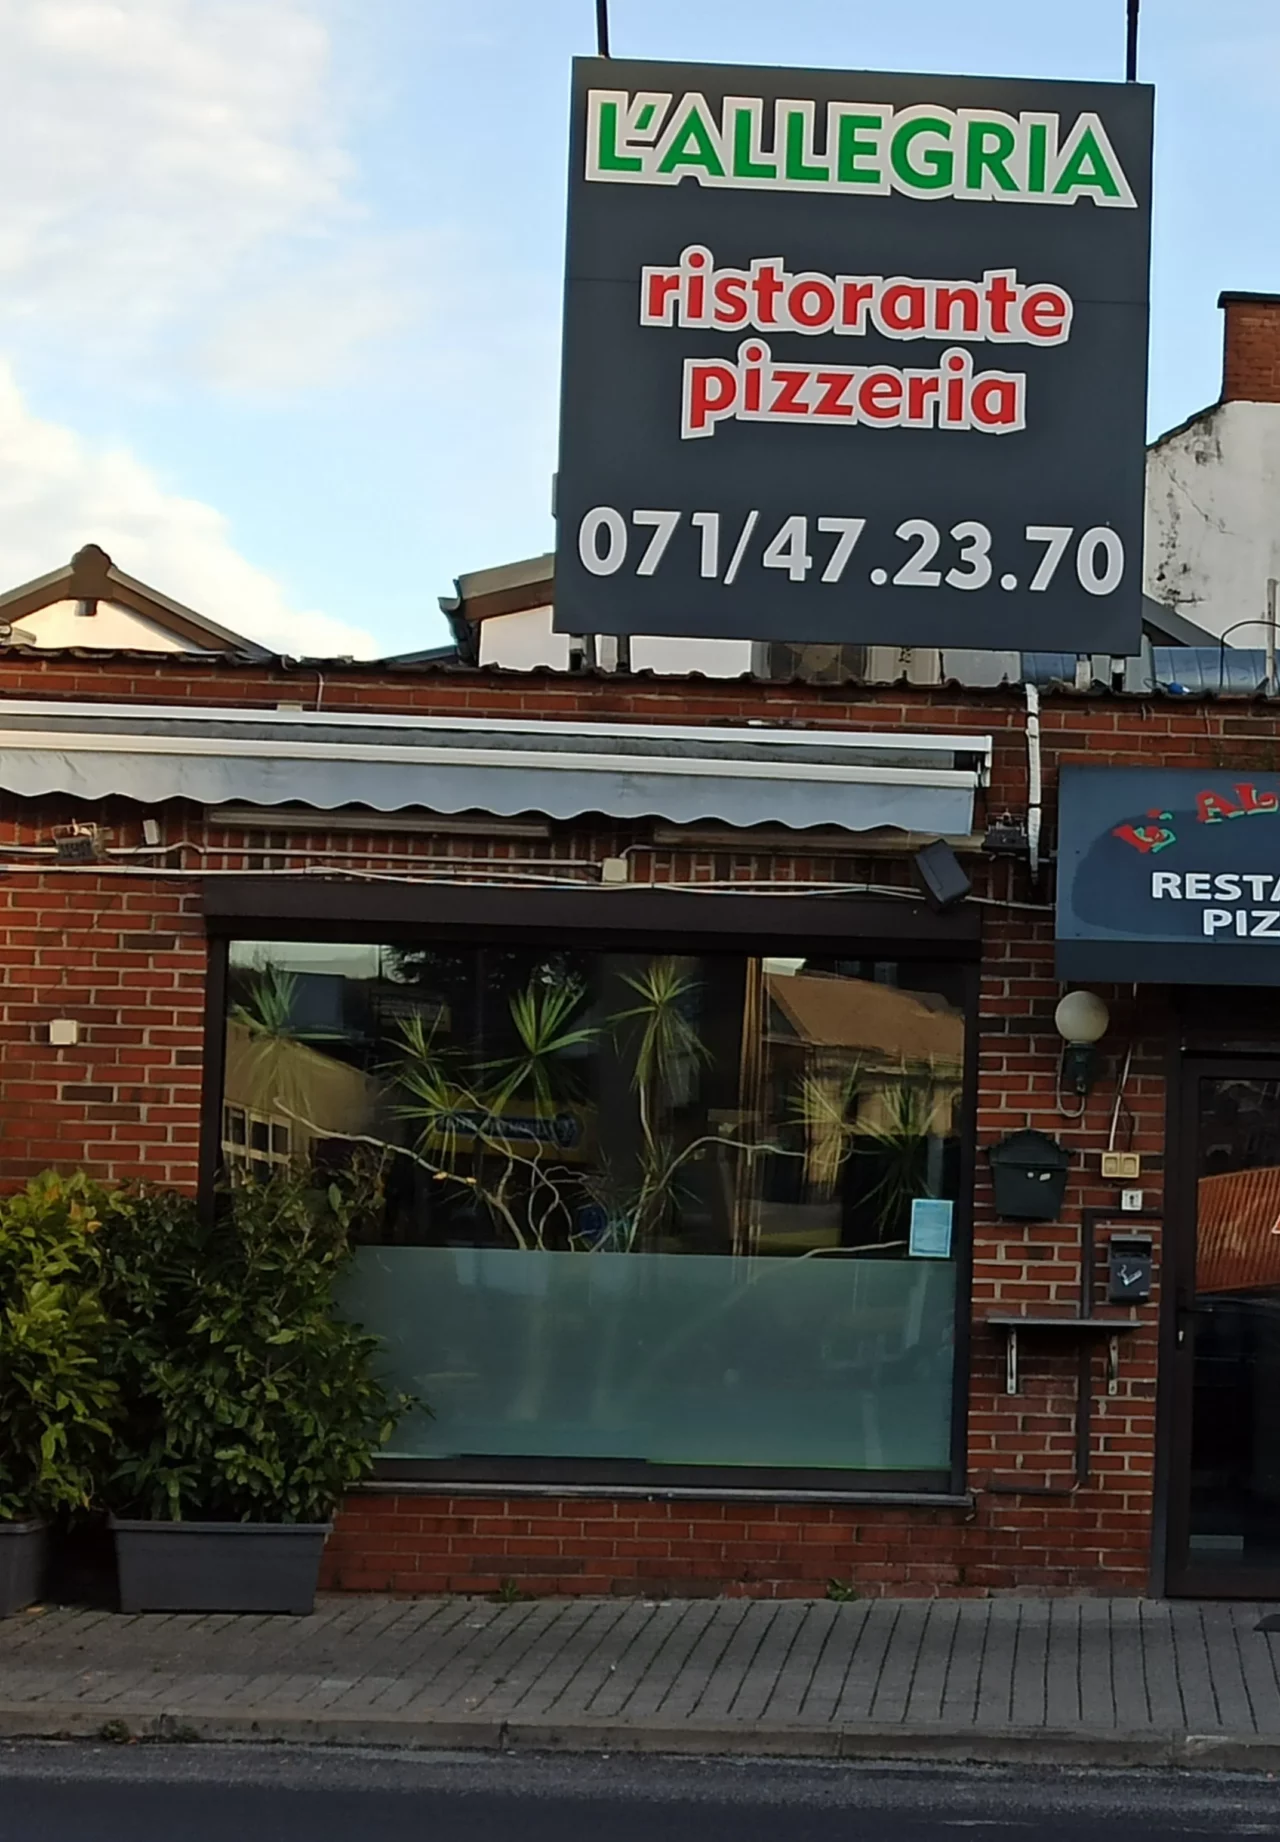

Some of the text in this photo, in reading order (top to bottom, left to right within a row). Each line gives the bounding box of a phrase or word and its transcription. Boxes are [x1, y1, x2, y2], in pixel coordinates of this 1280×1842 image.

[592, 98, 1126, 200] L'ALLEGRIA
[645, 251, 1069, 340] ristorante
[688, 345, 1019, 430] pizzeria
[577, 505, 1126, 596] 071/47.23.70
